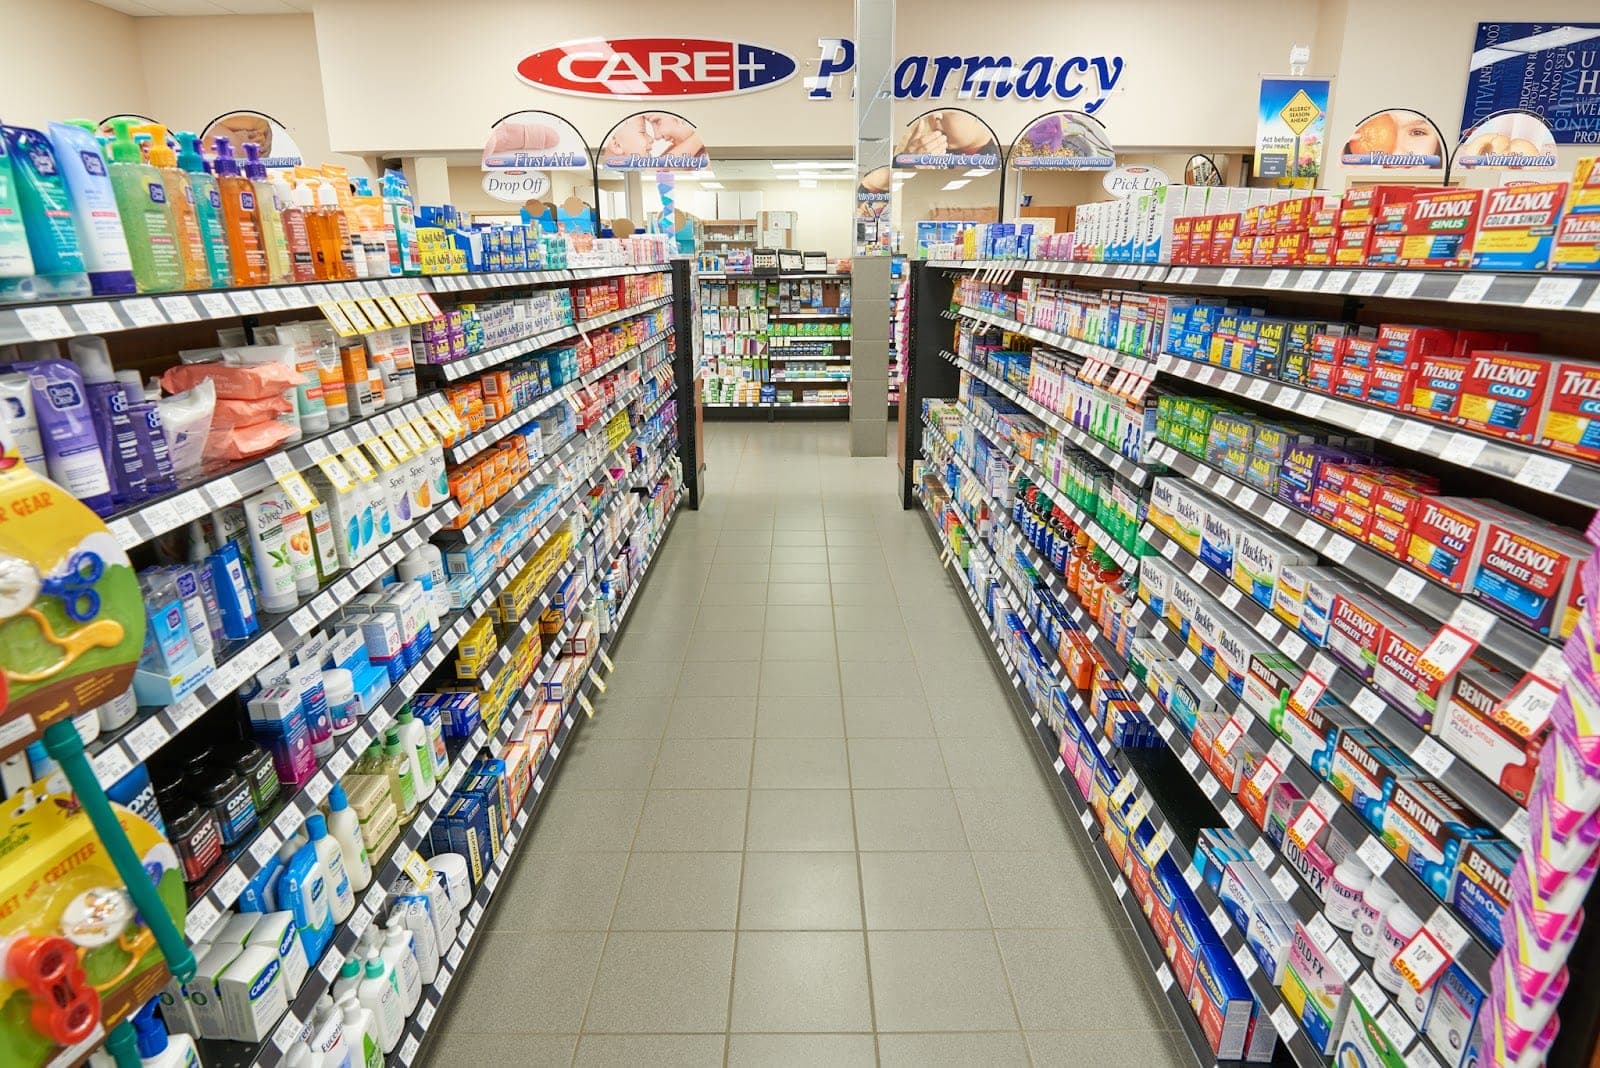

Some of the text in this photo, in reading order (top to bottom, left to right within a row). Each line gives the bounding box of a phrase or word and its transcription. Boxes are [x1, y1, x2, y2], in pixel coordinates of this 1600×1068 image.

[808, 38, 1124, 114] Parmacy
[1474, 82, 1496, 123] VALU
[514, 152, 574, 167] First Aid
[630, 154, 705, 170] Pain Relief
[920, 154, 997, 167] Cough & Cold
[1036, 157, 1064, 166] Natural
[1370, 151, 1427, 166] Vitamins
[1485, 152, 1554, 167] Nutritionals
[488, 177, 546, 193] Drop Off
[1112, 177, 1162, 190] Pick Up
[1282, 200, 1302, 214] Advil
[1415, 198, 1476, 220] TYLENOL
[1489, 191, 1555, 214] TYLENOL
[1175, 222, 1190, 234] Advil
[1195, 219, 1212, 233] Advil
[1217, 217, 1235, 232] Advil
[1430, 218, 1465, 230] SINUS
[1485, 215, 1507, 227] COLD
[1517, 213, 1548, 224] SINUS
[1278, 235, 1300, 248] Advil
[1240, 321, 1257, 333] Advil
[1260, 323, 1282, 339] Advil
[1382, 327, 1410, 341] TYLENOL
[1375, 367, 1404, 382] TYLENOL
[1422, 361, 1463, 382] TYLENOL
[1472, 357, 1540, 387] TYLENOL
[1431, 380, 1457, 390] COLD
[1491, 385, 1527, 398] COLD
[1230, 422, 1248, 436] Advil
[1259, 429, 1279, 444] Advil
[1227, 449, 1245, 463] Advil
[1252, 457, 1270, 472] Advil
[1290, 448, 1313, 469] Advil
[11, 492, 53, 517] GEAR
[1382, 490, 1408, 508] TYLENOL
[1205, 512, 1232, 544] Buckley's
[1375, 520, 1400, 537] TYLENOL
[1423, 503, 1476, 543] TYLENOL
[1442, 536, 1464, 551] FLU
[1491, 531, 1560, 576] TYLENOL
[1243, 536, 1273, 573] Buckley's
[1487, 554, 1530, 581] COMPLETE
[1334, 615, 1361, 642] COMPLETE
[1338, 599, 1377, 638] TYLENOL
[1220, 629, 1245, 668] Buckley's
[1252, 657, 1278, 689] BENYLIN
[1383, 655, 1417, 684] COMPLETE
[1418, 657, 1446, 680] Sale
[1290, 696, 1306, 718] Sale
[1457, 679, 1493, 718] BENYL
[1496, 708, 1531, 736] Sale
[1342, 735, 1379, 776] BENYLIN
[257, 760, 273, 780] OXY
[128, 786, 153, 812] OXY
[227, 787, 250, 811] OXY
[1248, 780, 1262, 800] Sale
[1396, 788, 1441, 837] BENYLIN
[191, 817, 213, 847] OXY
[1288, 828, 1306, 851] Sale
[280, 919, 296, 957] Cetaphil
[250, 960, 280, 999] Cetaphil
[1396, 958, 1422, 991] Sale
[322, 1022, 345, 1053] Eucerin
